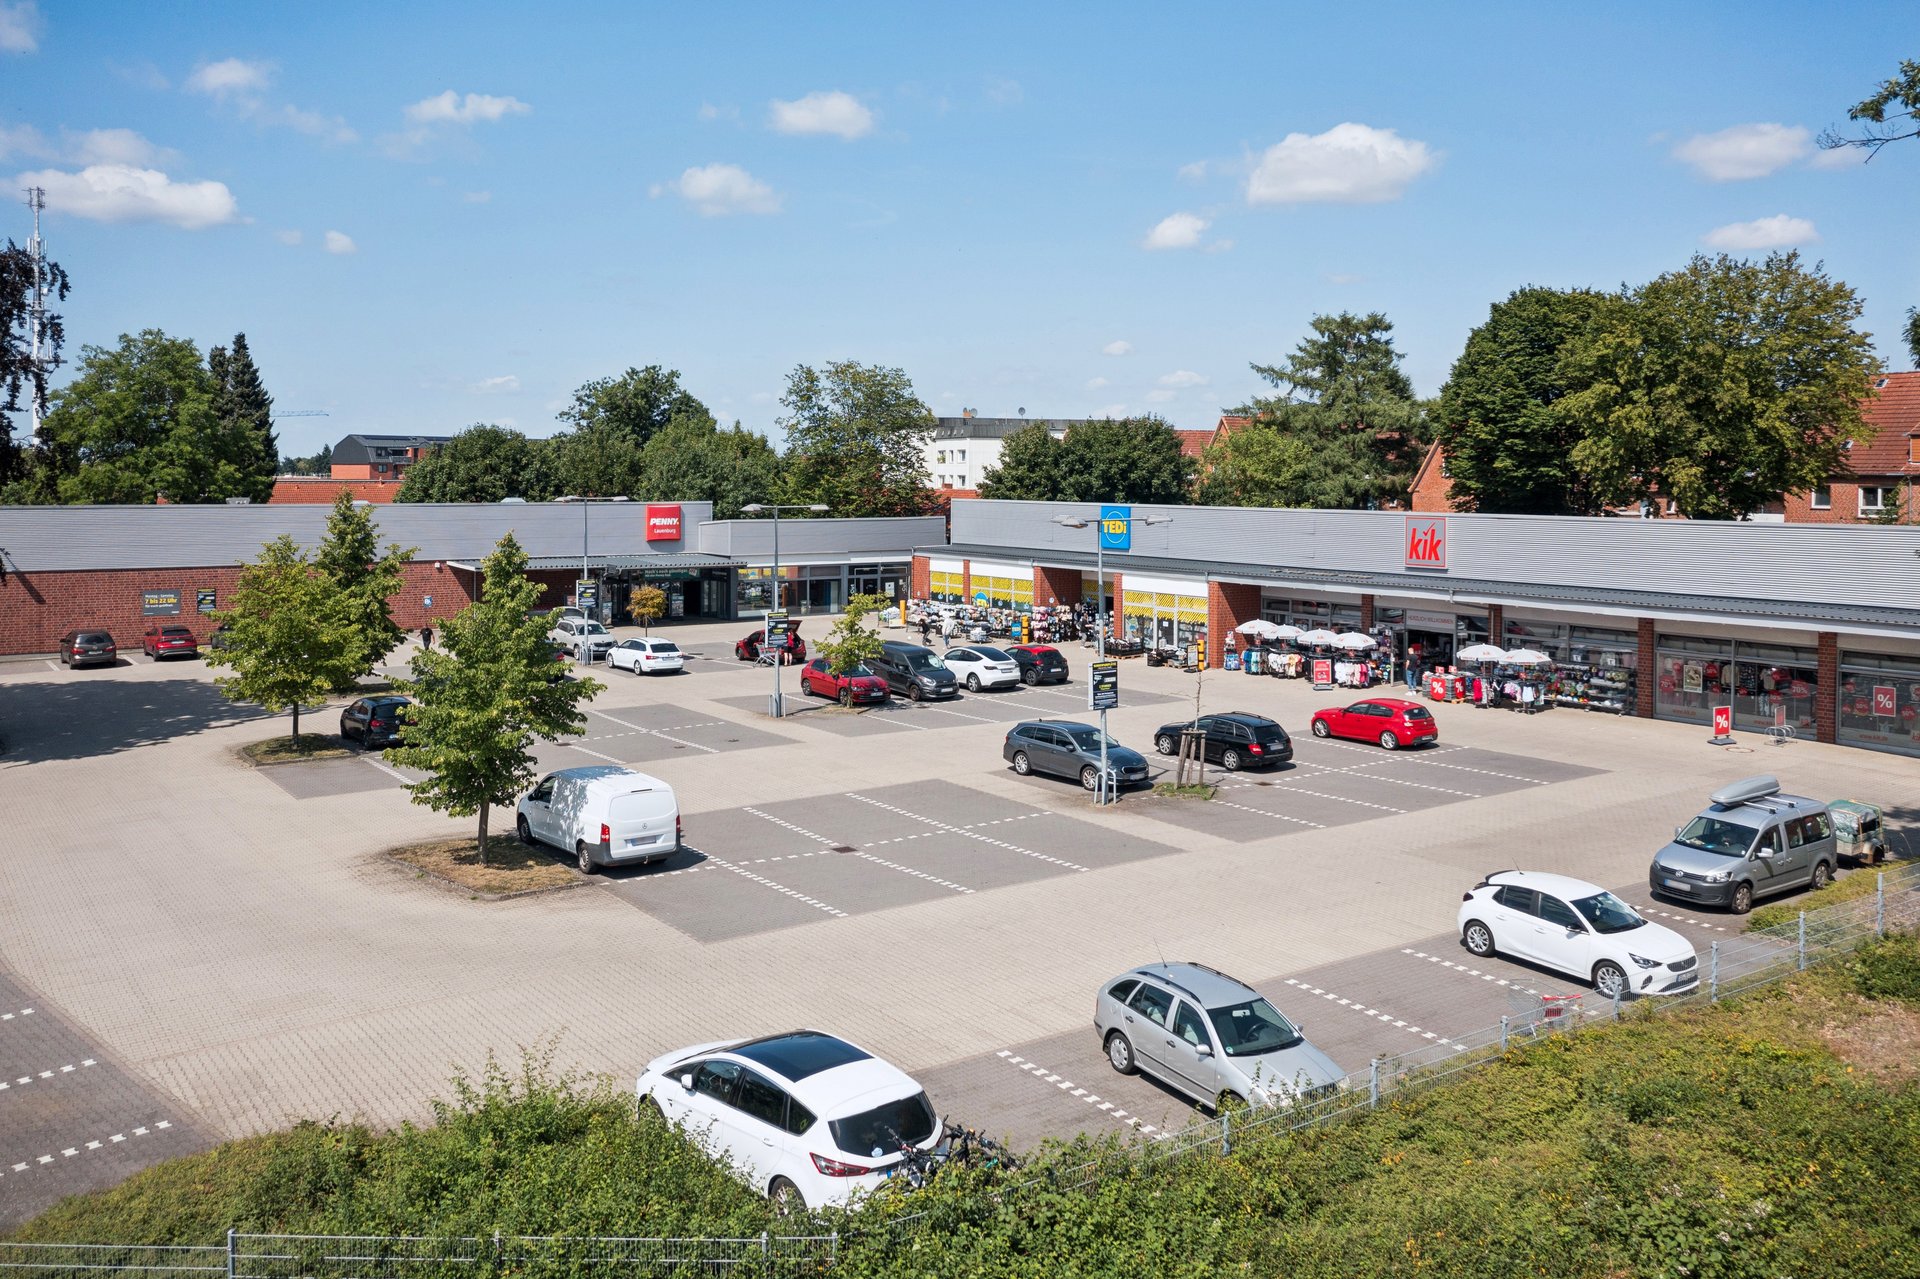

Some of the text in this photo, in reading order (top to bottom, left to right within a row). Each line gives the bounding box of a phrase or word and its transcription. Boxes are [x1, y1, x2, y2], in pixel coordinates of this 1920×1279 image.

[1103, 520, 1126, 534] TEDi
[1877, 694, 1892, 708] %
[1716, 714, 1728, 729] %
